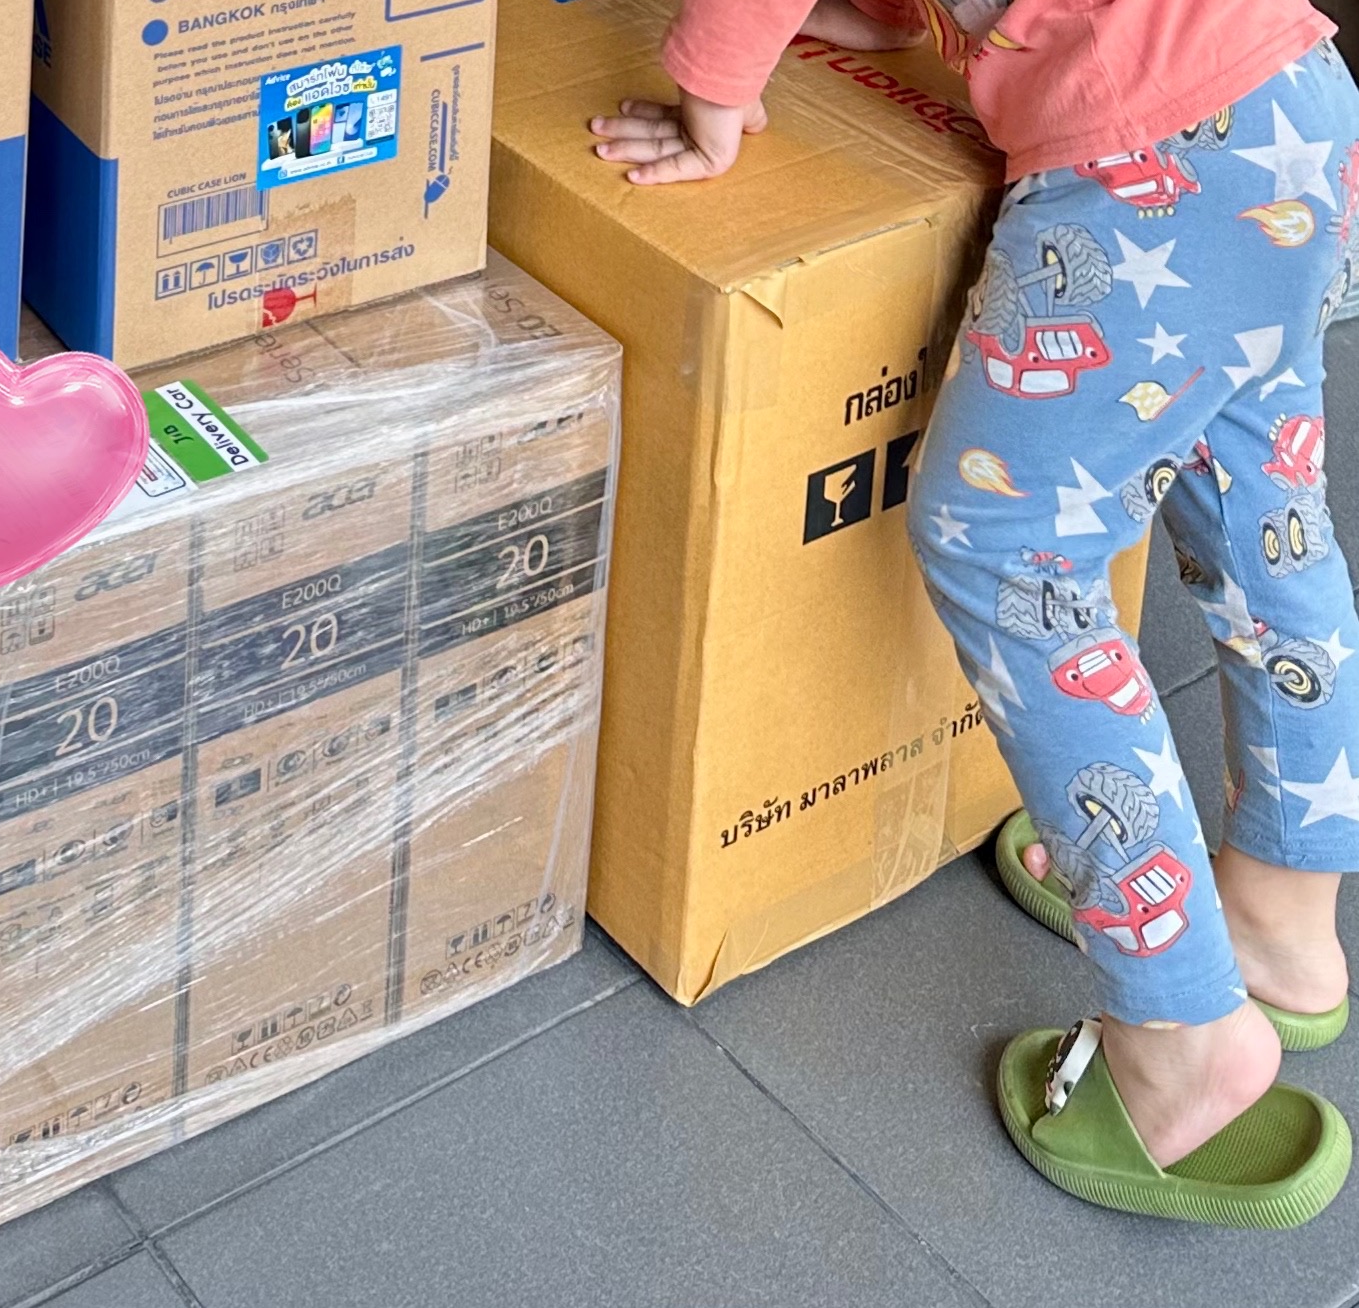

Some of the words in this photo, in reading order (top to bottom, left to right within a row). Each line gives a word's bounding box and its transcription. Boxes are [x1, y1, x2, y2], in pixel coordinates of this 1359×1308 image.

[178, 3, 265, 35] BANGKOK
[167, 183, 197, 200] CUBIC
[198, 178, 224, 194] CASE
[224, 172, 247, 187] LION
[166, 388, 200, 411] Car
[163, 424, 193, 445] JIB
[188, 412, 249, 468] Delivery
[497, 495, 553, 532] E200Q
[498, 534, 551, 591] 20
[280, 573, 343, 610] E200Q
[280, 613, 339, 672] 20
[56, 696, 119, 760] 20
